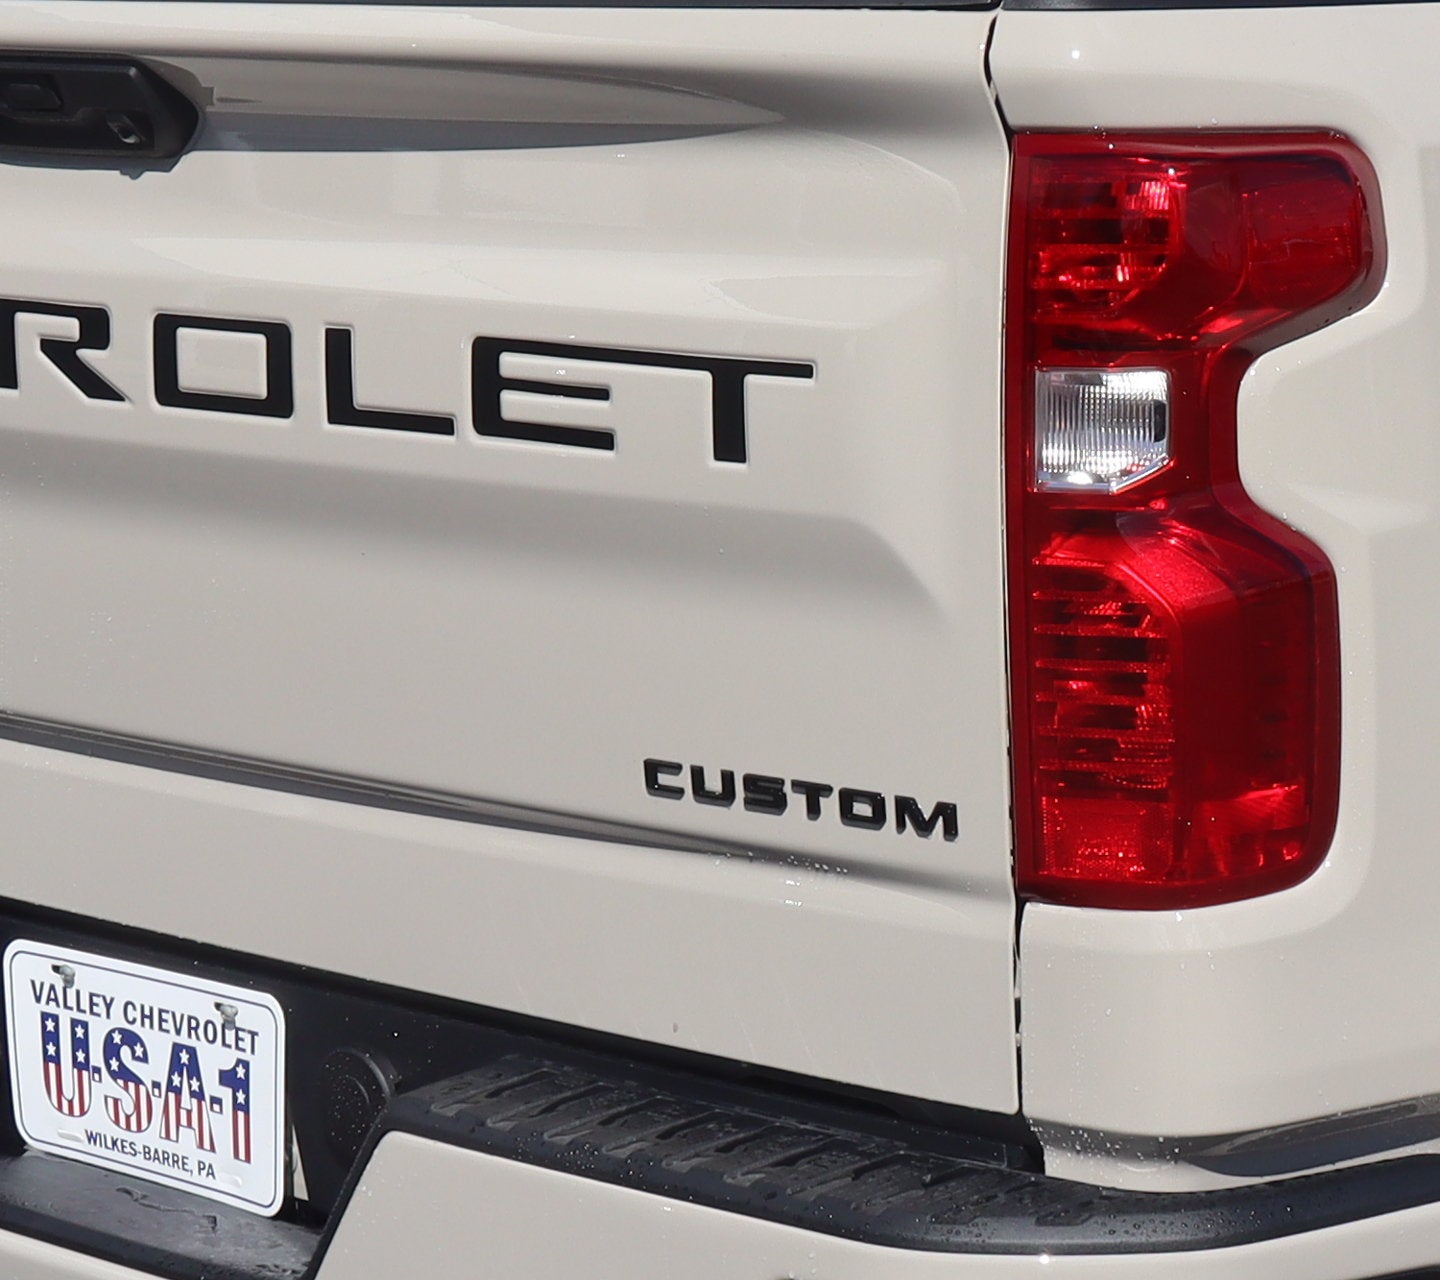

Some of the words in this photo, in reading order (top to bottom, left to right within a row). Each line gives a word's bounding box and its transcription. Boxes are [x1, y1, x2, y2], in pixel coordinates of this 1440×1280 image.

[643, 758, 959, 842] CUSTOM
[30, 979, 115, 1020] VALLEY
[123, 1000, 259, 1055] CHEVROLET
[84, 1129, 194, 1176] WILKES-BARRE,
[198, 1160, 216, 1180] PA
